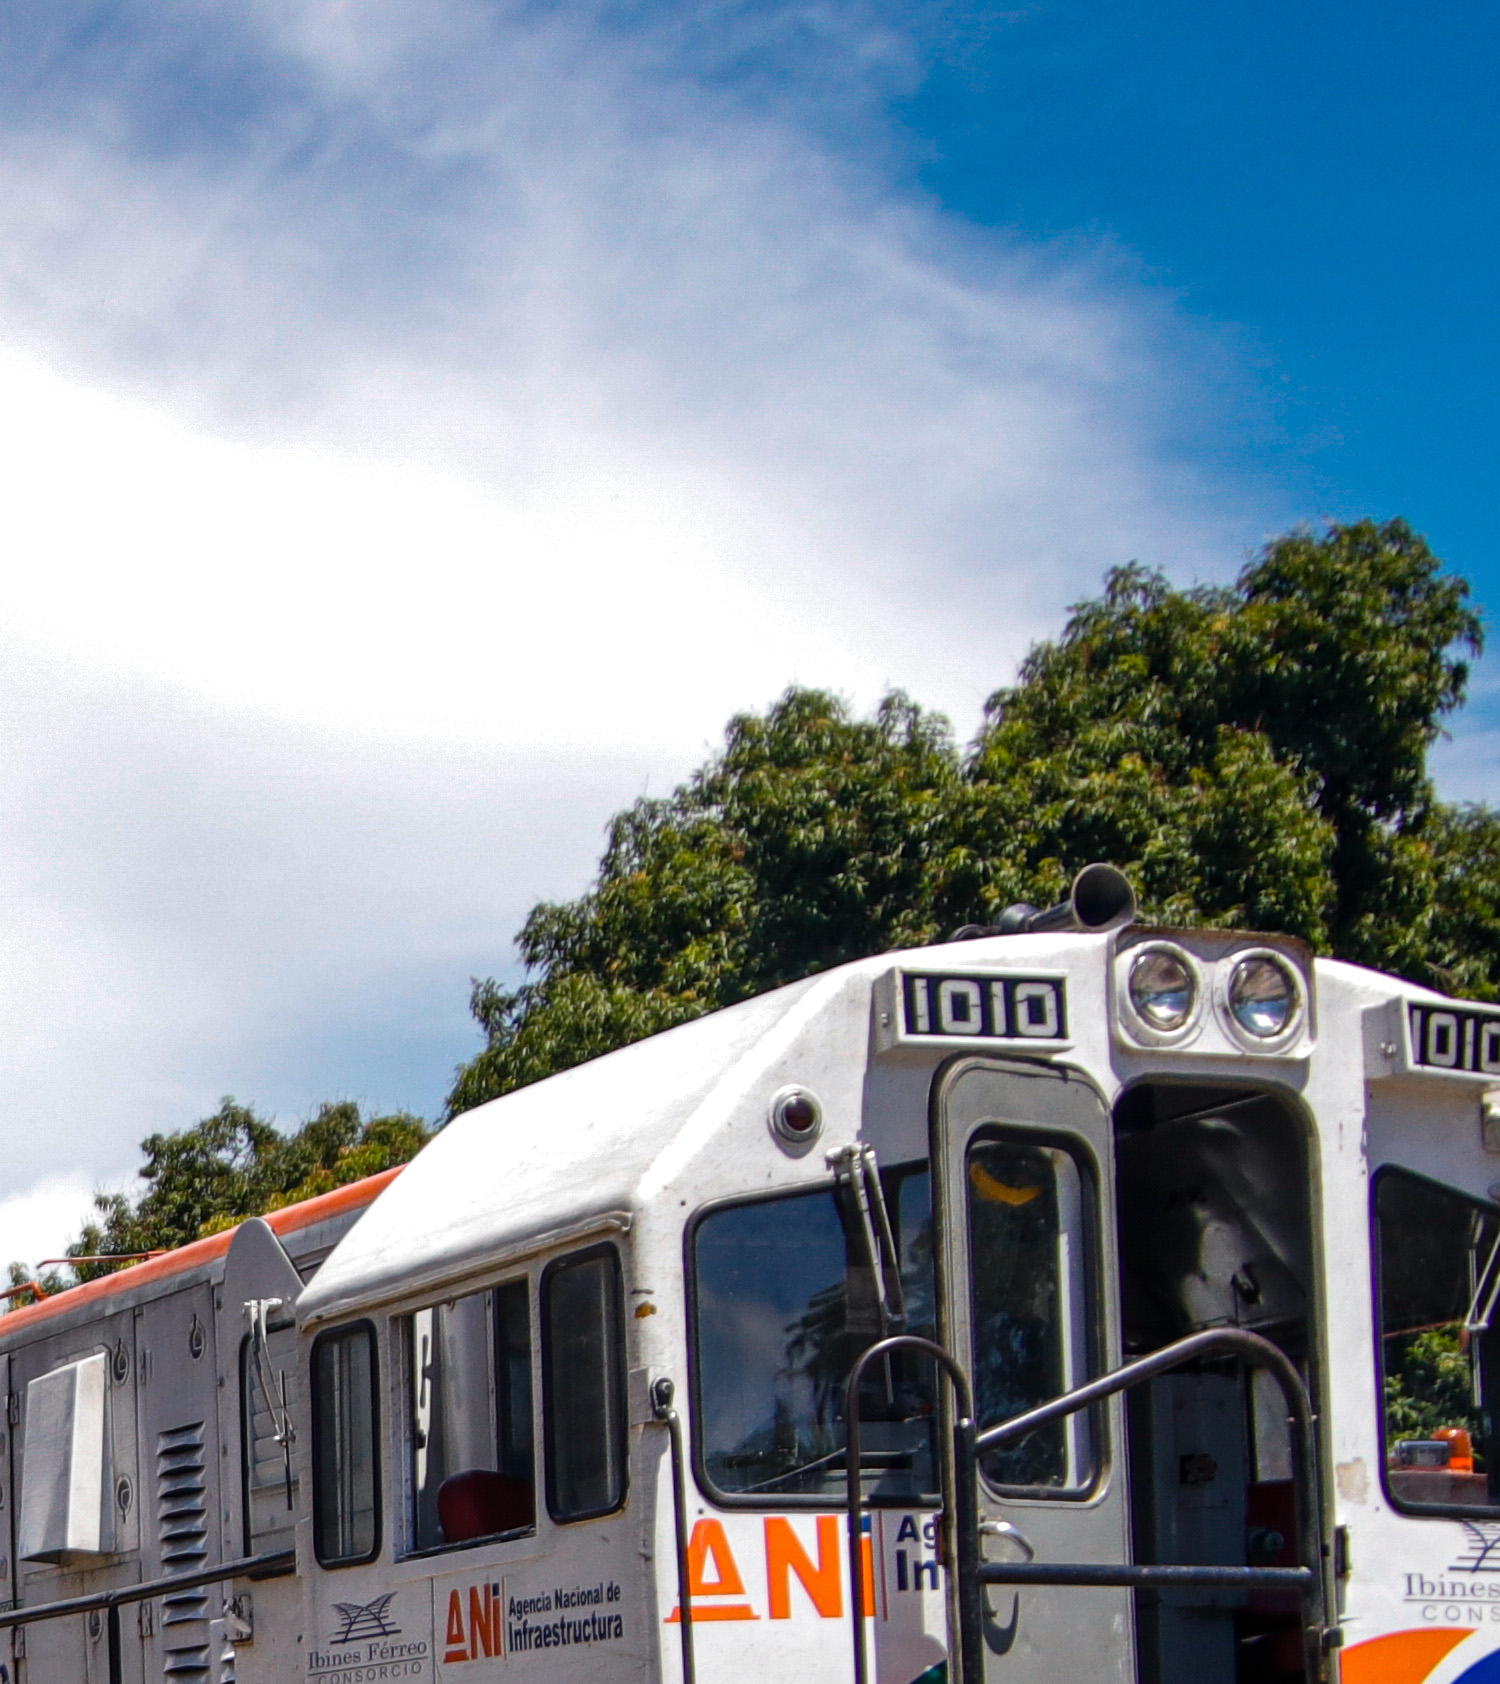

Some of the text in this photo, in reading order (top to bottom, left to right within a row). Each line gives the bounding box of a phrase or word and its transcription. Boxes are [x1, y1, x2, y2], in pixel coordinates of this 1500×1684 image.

[912, 976, 1059, 1037] 1010
[508, 1580, 622, 1621] Agencia Nacional de
[508, 1611, 625, 1652] Infraestructura
[307, 1639, 428, 1670] Ibines Férreo
